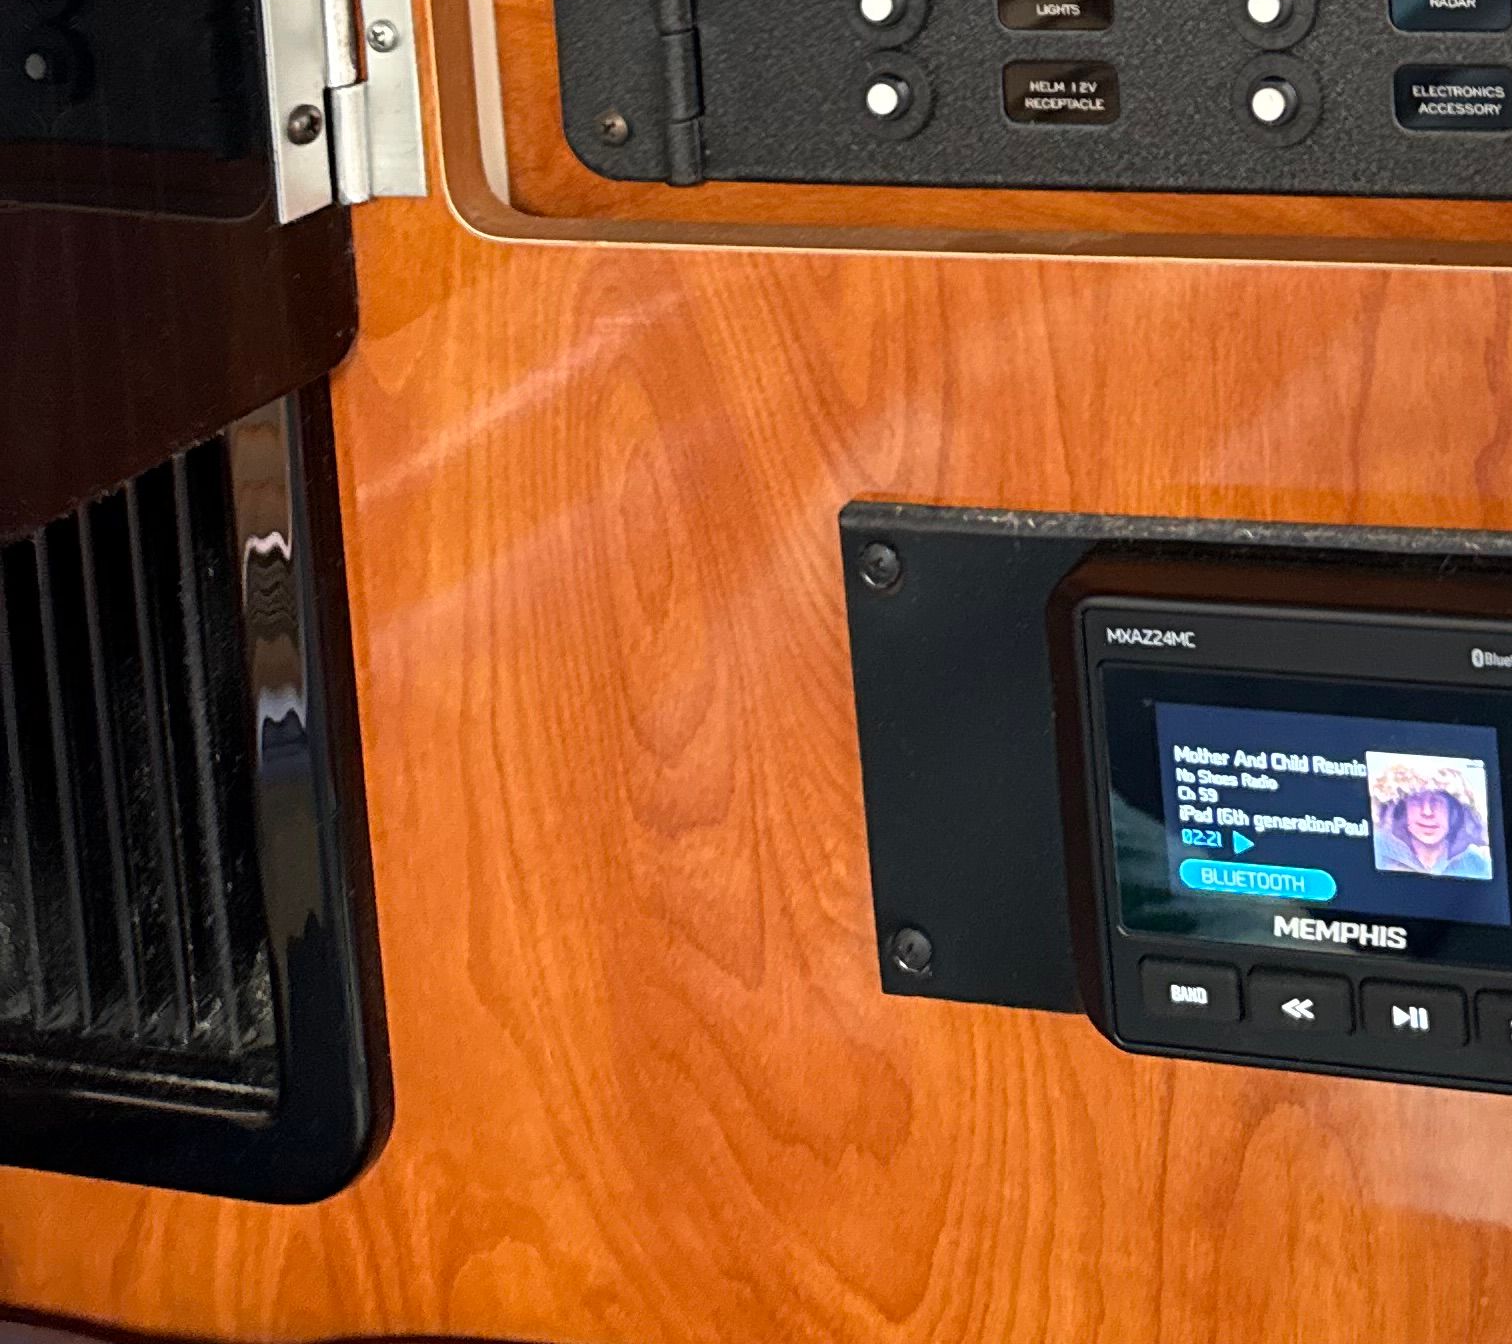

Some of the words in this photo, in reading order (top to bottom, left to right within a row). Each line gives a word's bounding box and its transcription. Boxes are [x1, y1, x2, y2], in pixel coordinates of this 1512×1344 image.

[1412, 86, 1505, 99] ELECTRONICS
[1024, 98, 1105, 111] RECEPTACLE
[1419, 104, 1502, 115] ACCESSORY
[1106, 627, 1196, 649] MXAZ24MC
[1174, 745, 1230, 767] Mother
[1234, 750, 1268, 768] And
[1272, 753, 1309, 773] Child
[1176, 768, 1196, 783] No
[1199, 770, 1238, 788] Shoes
[1241, 773, 1280, 790] Radio
[1177, 786, 1196, 802] Ch
[1199, 787, 1219, 803] 59
[1201, 868, 1304, 892] BLUETOOTH
[1273, 915, 1407, 949] MEMPHIS
[1170, 985, 1208, 1004] BAND
